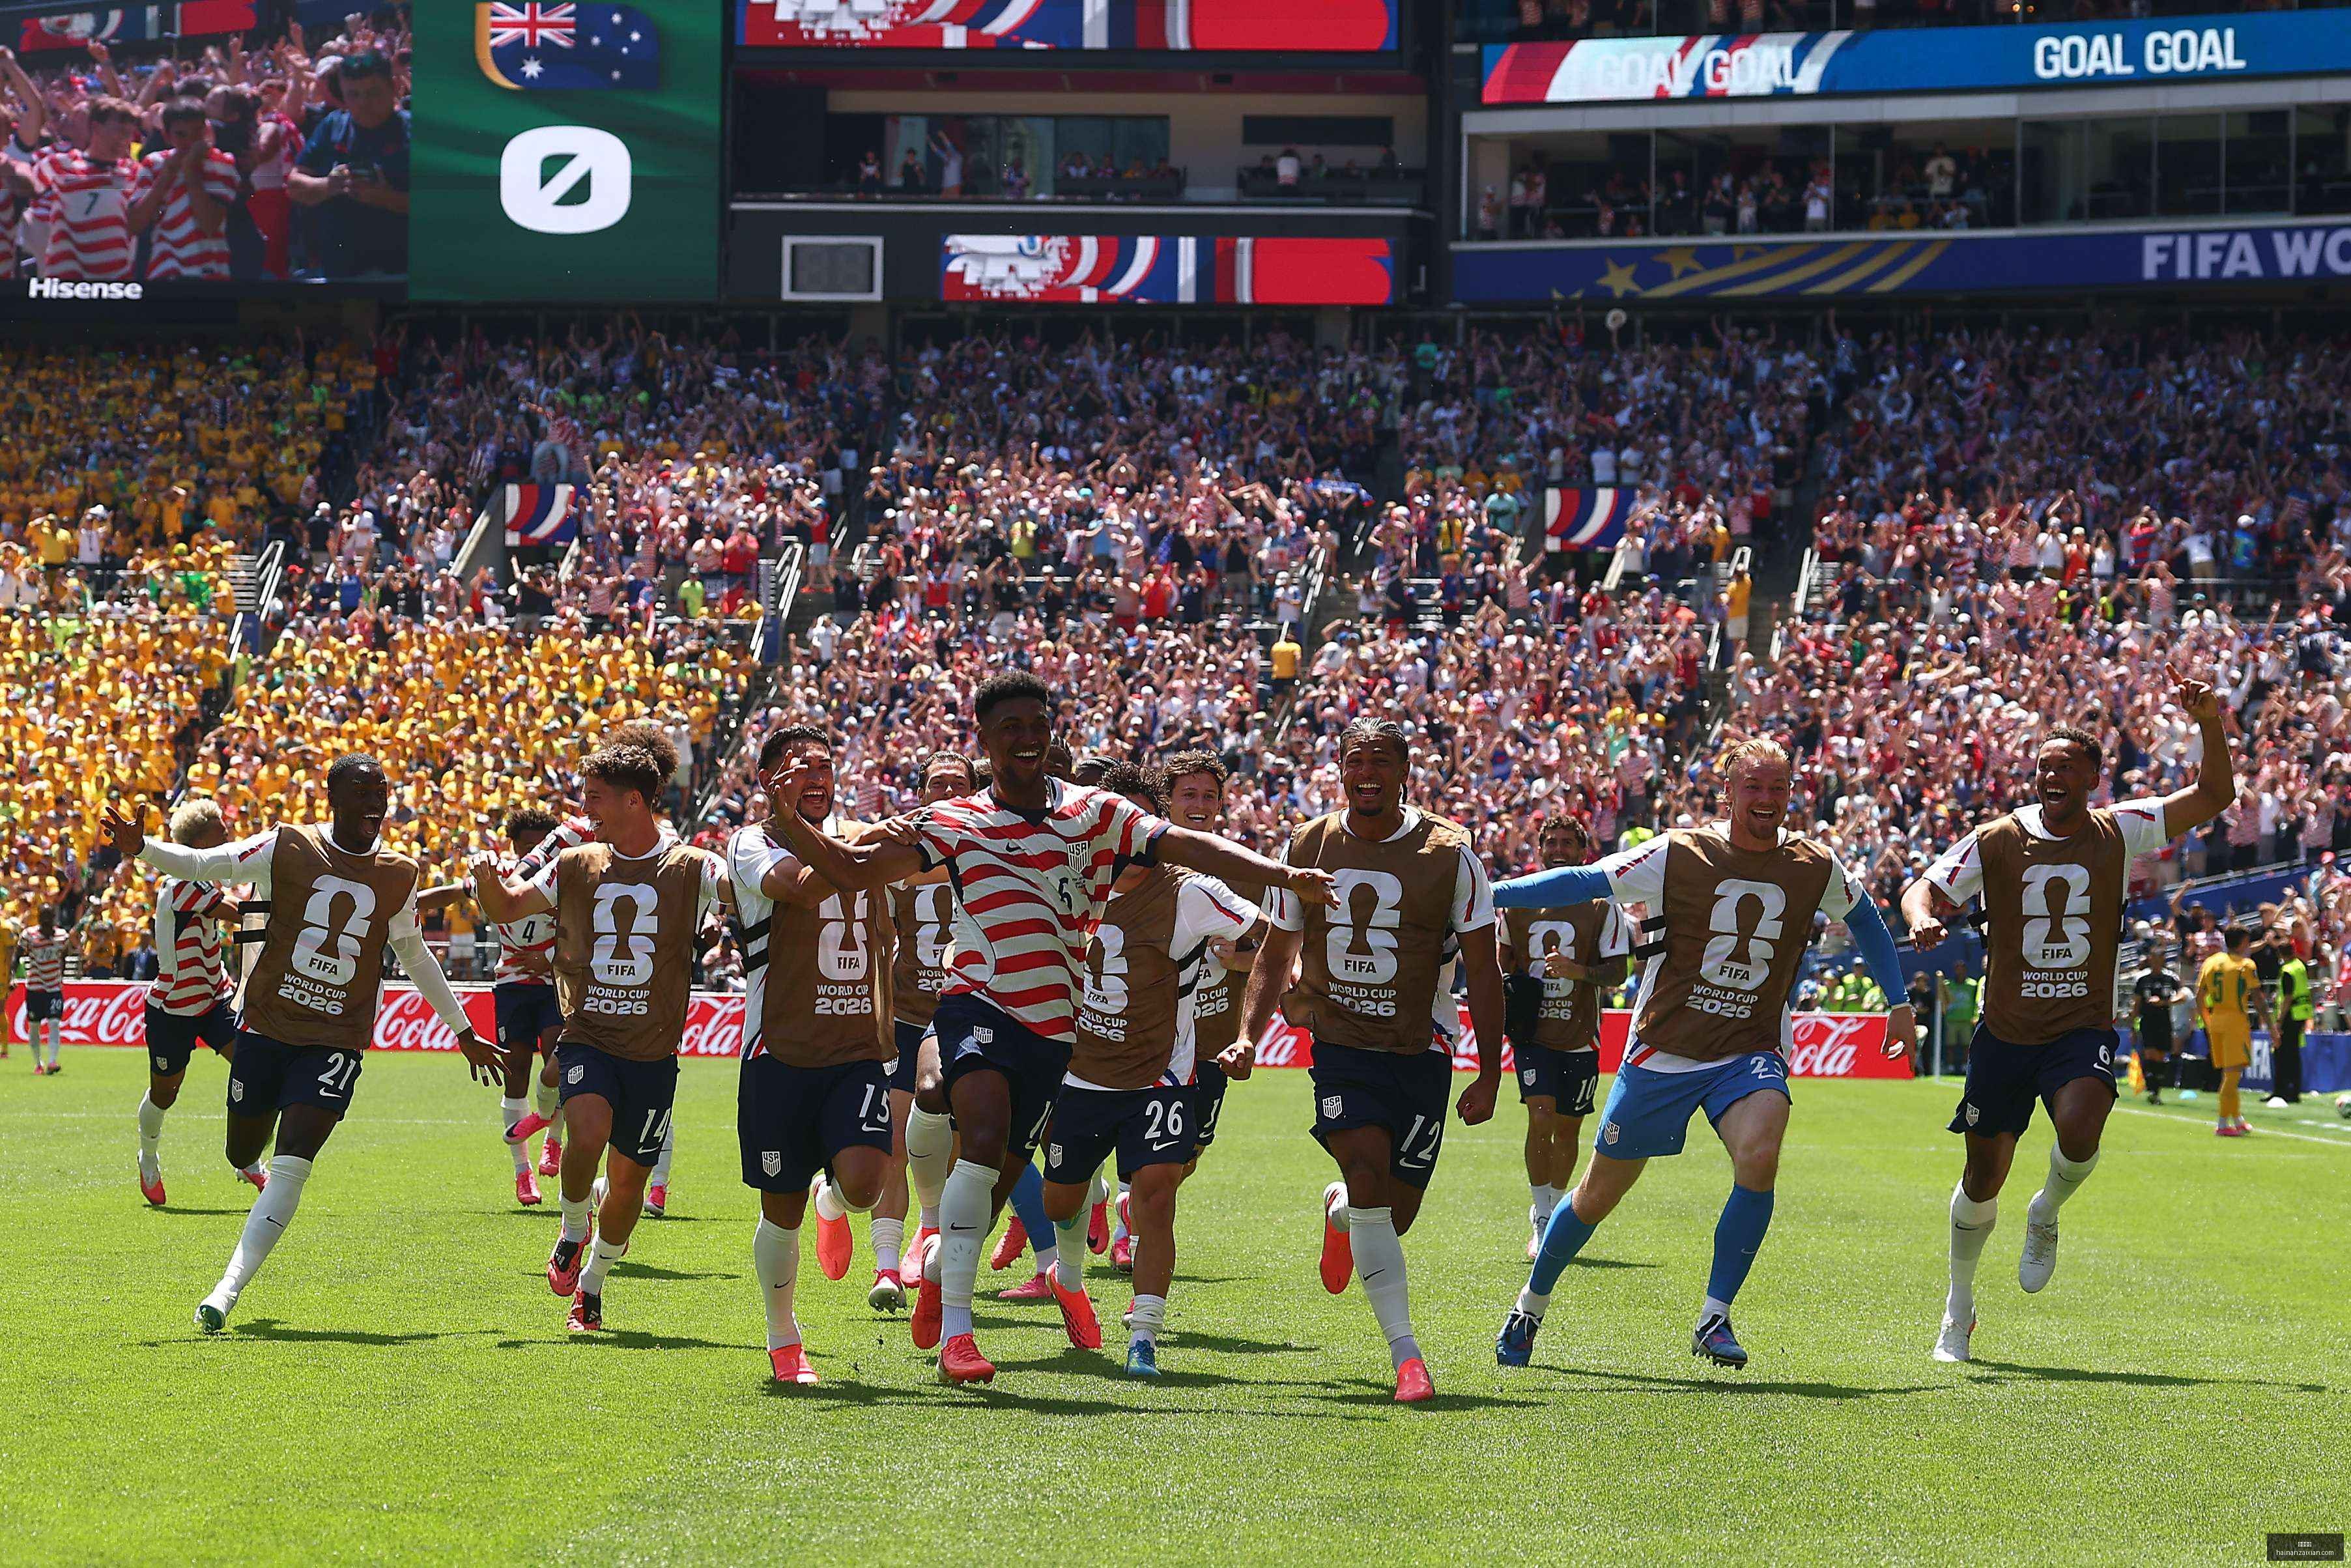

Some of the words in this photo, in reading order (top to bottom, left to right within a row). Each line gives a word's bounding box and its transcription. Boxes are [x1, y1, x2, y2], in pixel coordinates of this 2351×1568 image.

[2034, 33, 2135, 79] GOAL
[2144, 27, 2247, 74] GOAL
[1596, 51, 1692, 91] GOAL
[1704, 44, 1800, 89] GOAL
[2143, 233, 2264, 280] FIFA
[28, 277, 143, 299] Hisense
[1069, 842, 1087, 856] USA
[522, 920, 535, 943] 4
[837, 956, 860, 969] FIFA
[2042, 948, 2073, 959] FIFA
[308, 958, 338, 975] FIFA
[607, 965, 635, 976] FIFA
[1199, 969, 1212, 980] FA
[1344, 960, 1376, 973] FIFA
[1718, 965, 1750, 981] FIFA
[917, 978, 945, 991] 20
[2023, 971, 2064, 981] WORLD
[2066, 971, 2088, 980] CUP
[284, 973, 324, 993] WORLD
[325, 988, 347, 999] CUP
[588, 985, 627, 999] WORLD
[629, 990, 650, 999] CUP
[817, 984, 853, 995] WORLD
[855, 984, 869, 995] CUP
[1210, 987, 1229, 999] CUP
[1328, 981, 1369, 997] WORLD
[1370, 989, 1397, 999] CUP
[1693, 984, 1735, 1000] WORLD
[1736, 993, 1758, 1004] CUP
[2021, 982, 2088, 998] 2026
[278, 984, 344, 1016] 2026
[584, 997, 648, 1015] 2026
[815, 997, 872, 1016] 2026
[1685, 995, 1752, 1019] 2026
[1081, 1007, 1102, 1023] ORLD
[1104, 1017, 1128, 1028] CUP
[1538, 1008, 1572, 1020] 026
[1078, 1016, 1125, 1042] 026
[2099, 1045, 2110, 1065] 6
[318, 1053, 356, 1090] 21
[1576, 1076, 1596, 1104] 10
[1324, 1097, 1340, 1106] USA
[640, 1107, 671, 1143] 14
[1145, 1100, 1183, 1139] 26
[1607, 1122, 1618, 1133] USA
[1401, 1114, 1440, 1161] 12
[763, 1152, 779, 1162] USA
[1051, 1145, 1062, 1154] USA
